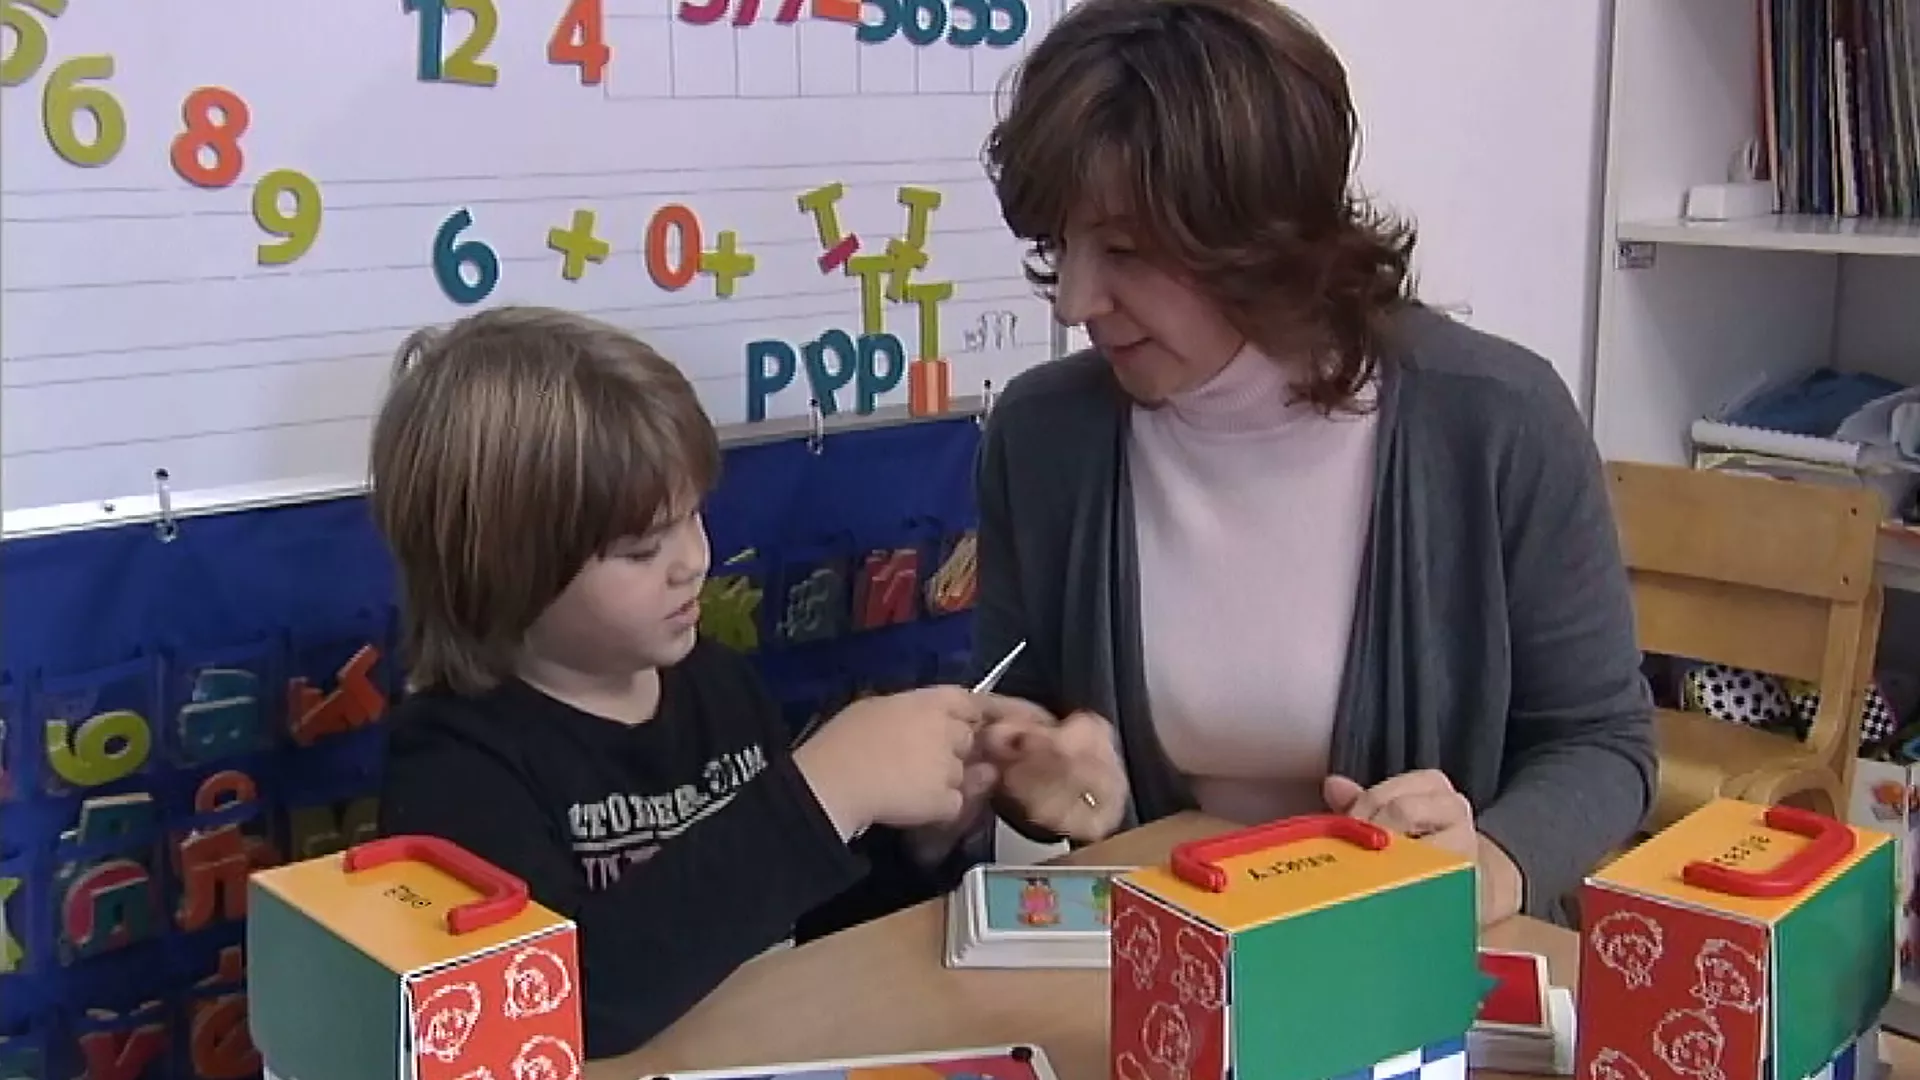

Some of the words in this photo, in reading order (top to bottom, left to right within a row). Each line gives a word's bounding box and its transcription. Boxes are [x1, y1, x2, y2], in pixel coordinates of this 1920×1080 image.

[43, 54, 126, 168] 6
[170, 86, 250, 188] 8
[252, 168, 322, 266] 9
[433, 207, 500, 304] 6
